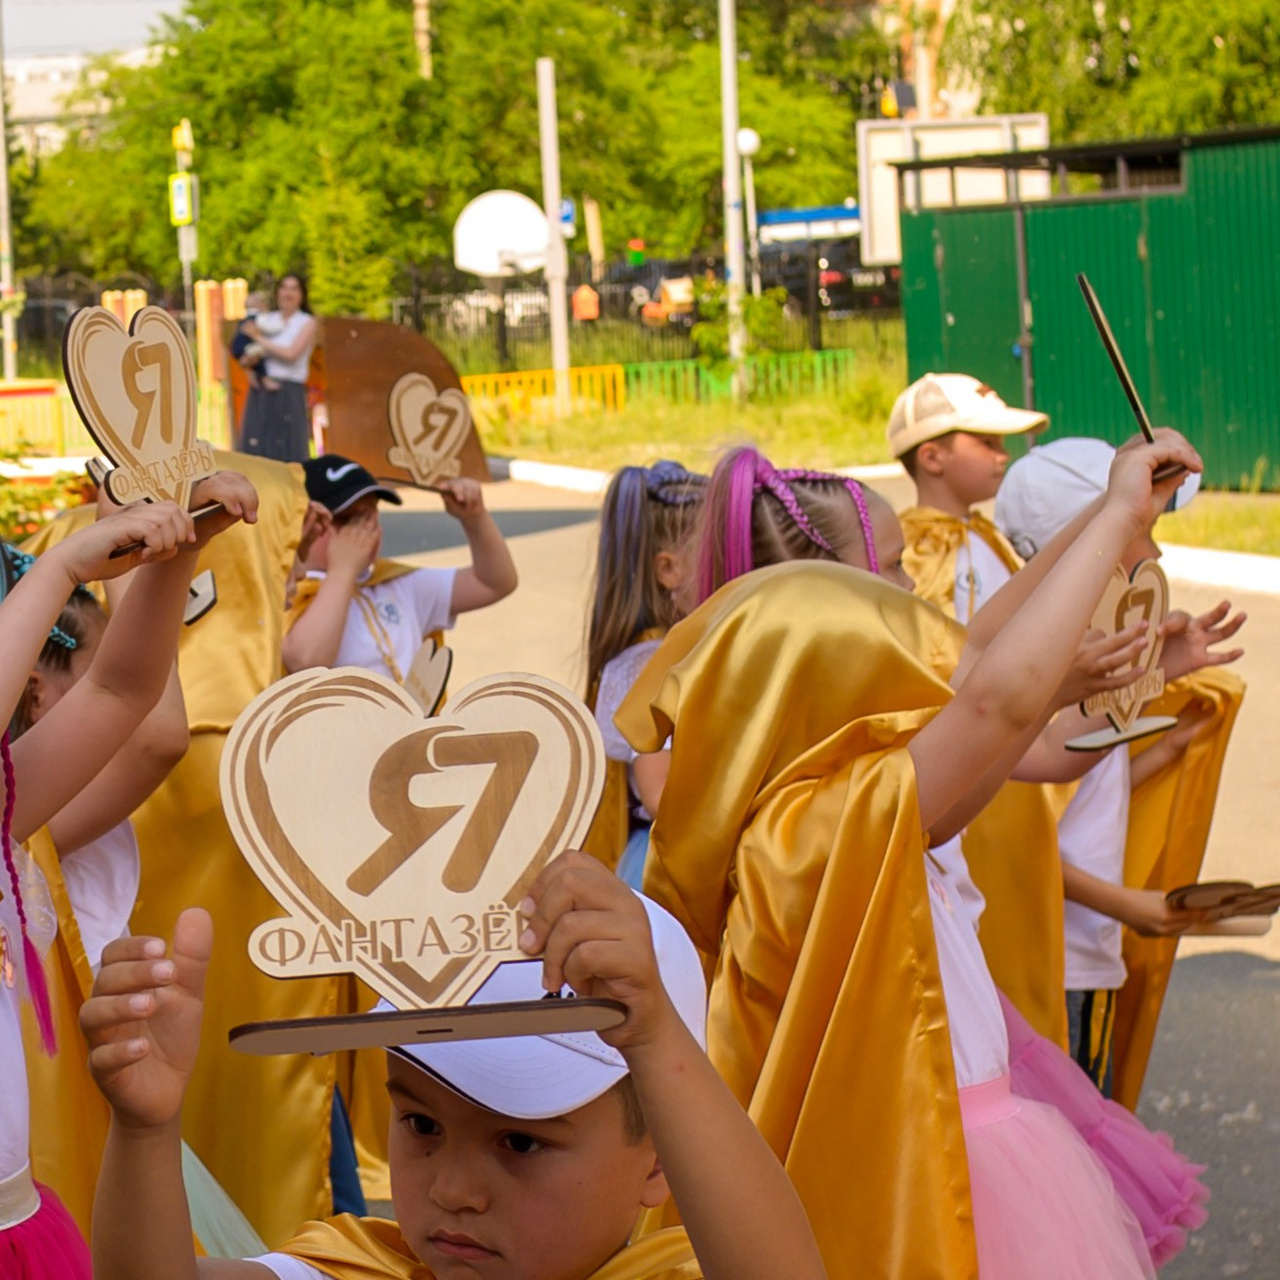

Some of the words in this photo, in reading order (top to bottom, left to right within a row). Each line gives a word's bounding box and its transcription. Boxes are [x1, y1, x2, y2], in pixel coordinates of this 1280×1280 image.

[121, 340, 173, 450] Я
[412, 401, 458, 452] Я
[113, 446, 214, 498] ФАНТАЗЁРЫ
[346, 725, 539, 897] Я
[258, 903, 526, 967] ФАНТАЗЁ
